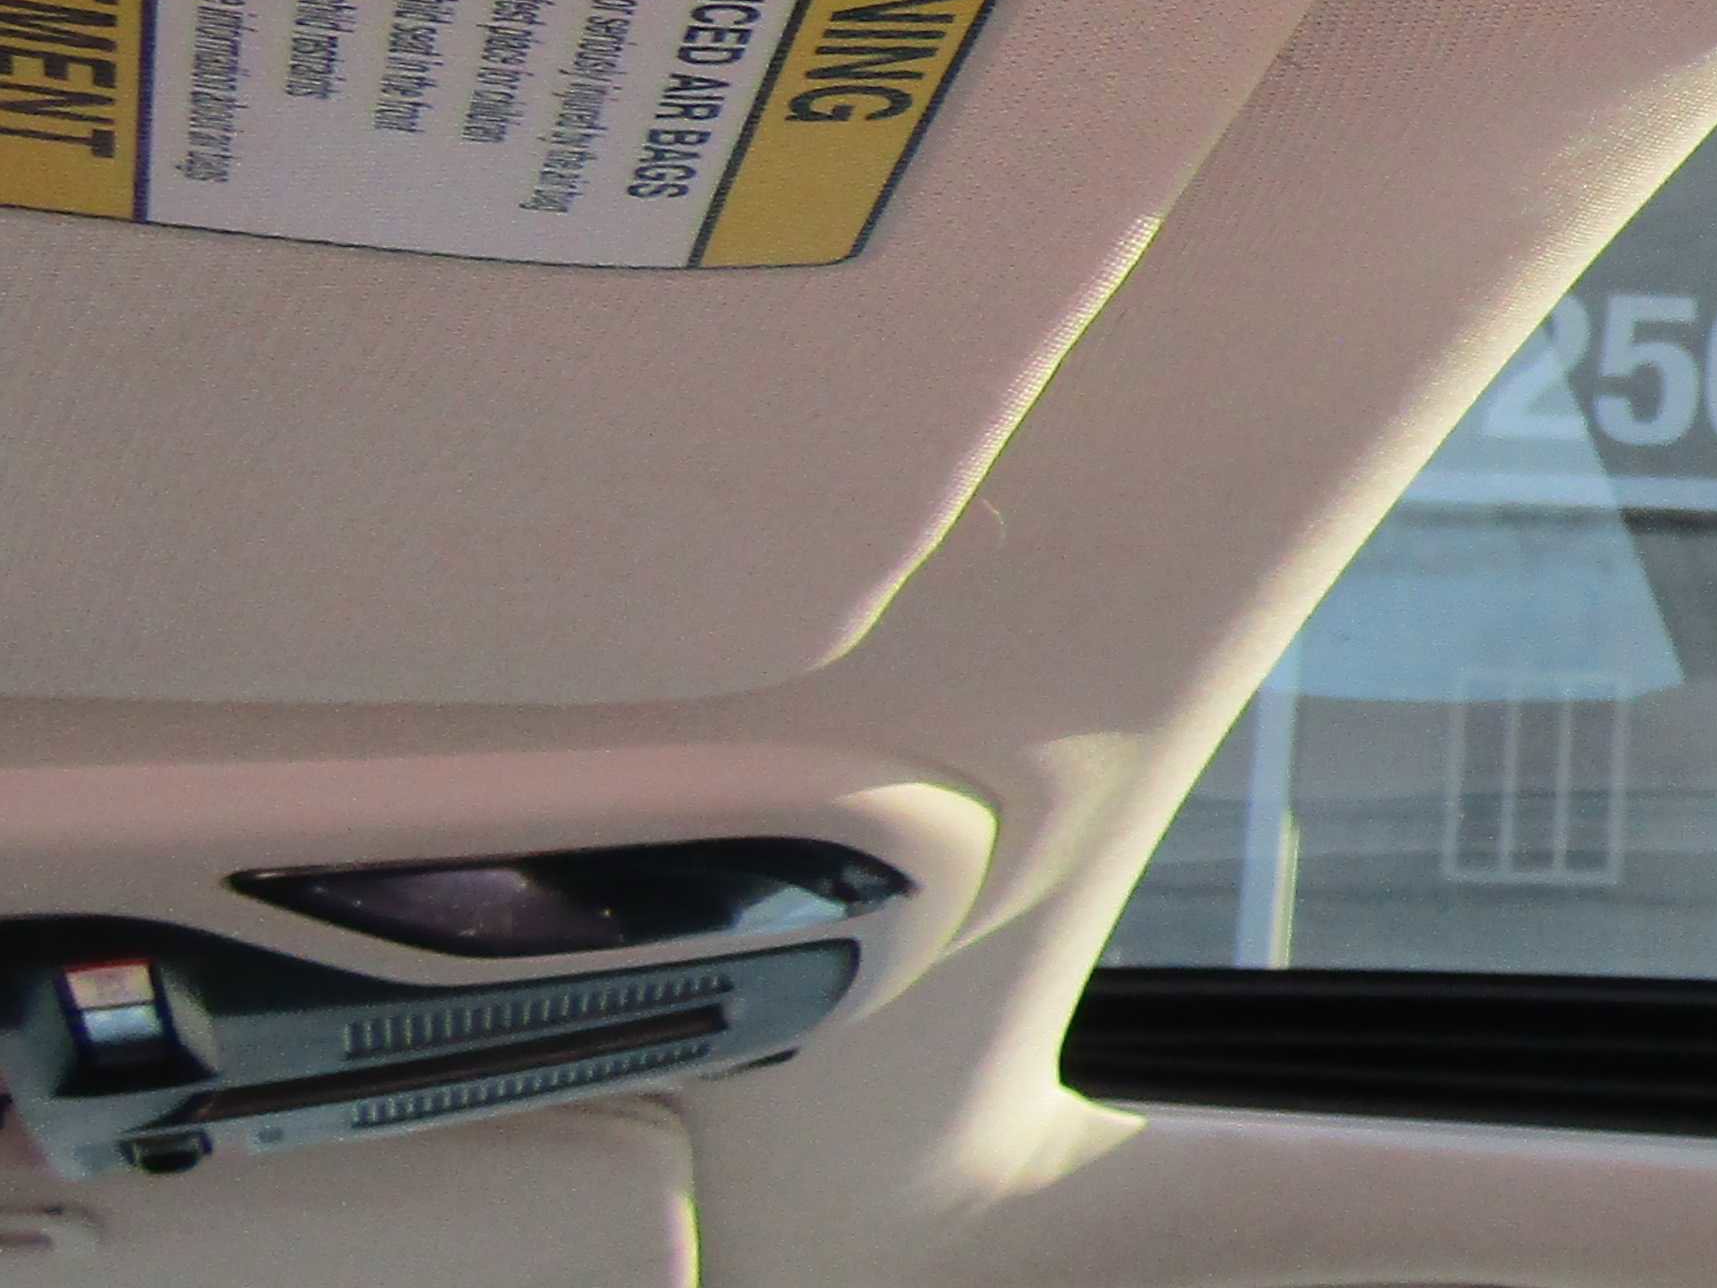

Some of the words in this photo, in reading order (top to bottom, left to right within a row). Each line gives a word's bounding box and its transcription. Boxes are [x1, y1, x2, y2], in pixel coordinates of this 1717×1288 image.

[191, 5, 256, 92] information
[387, 22, 443, 58] seat
[475, 23, 540, 66] place
[558, 15, 636, 83] seriously
[284, 30, 346, 100] restraints
[379, 73, 437, 98] the
[385, 56, 444, 74] in
[476, 66, 534, 91] for
[373, 97, 433, 134] front
[462, 89, 523, 143] children
[552, 82, 622, 131] injured
[653, 72, 732, 122] AIR
[625, 128, 712, 199] BAGS
